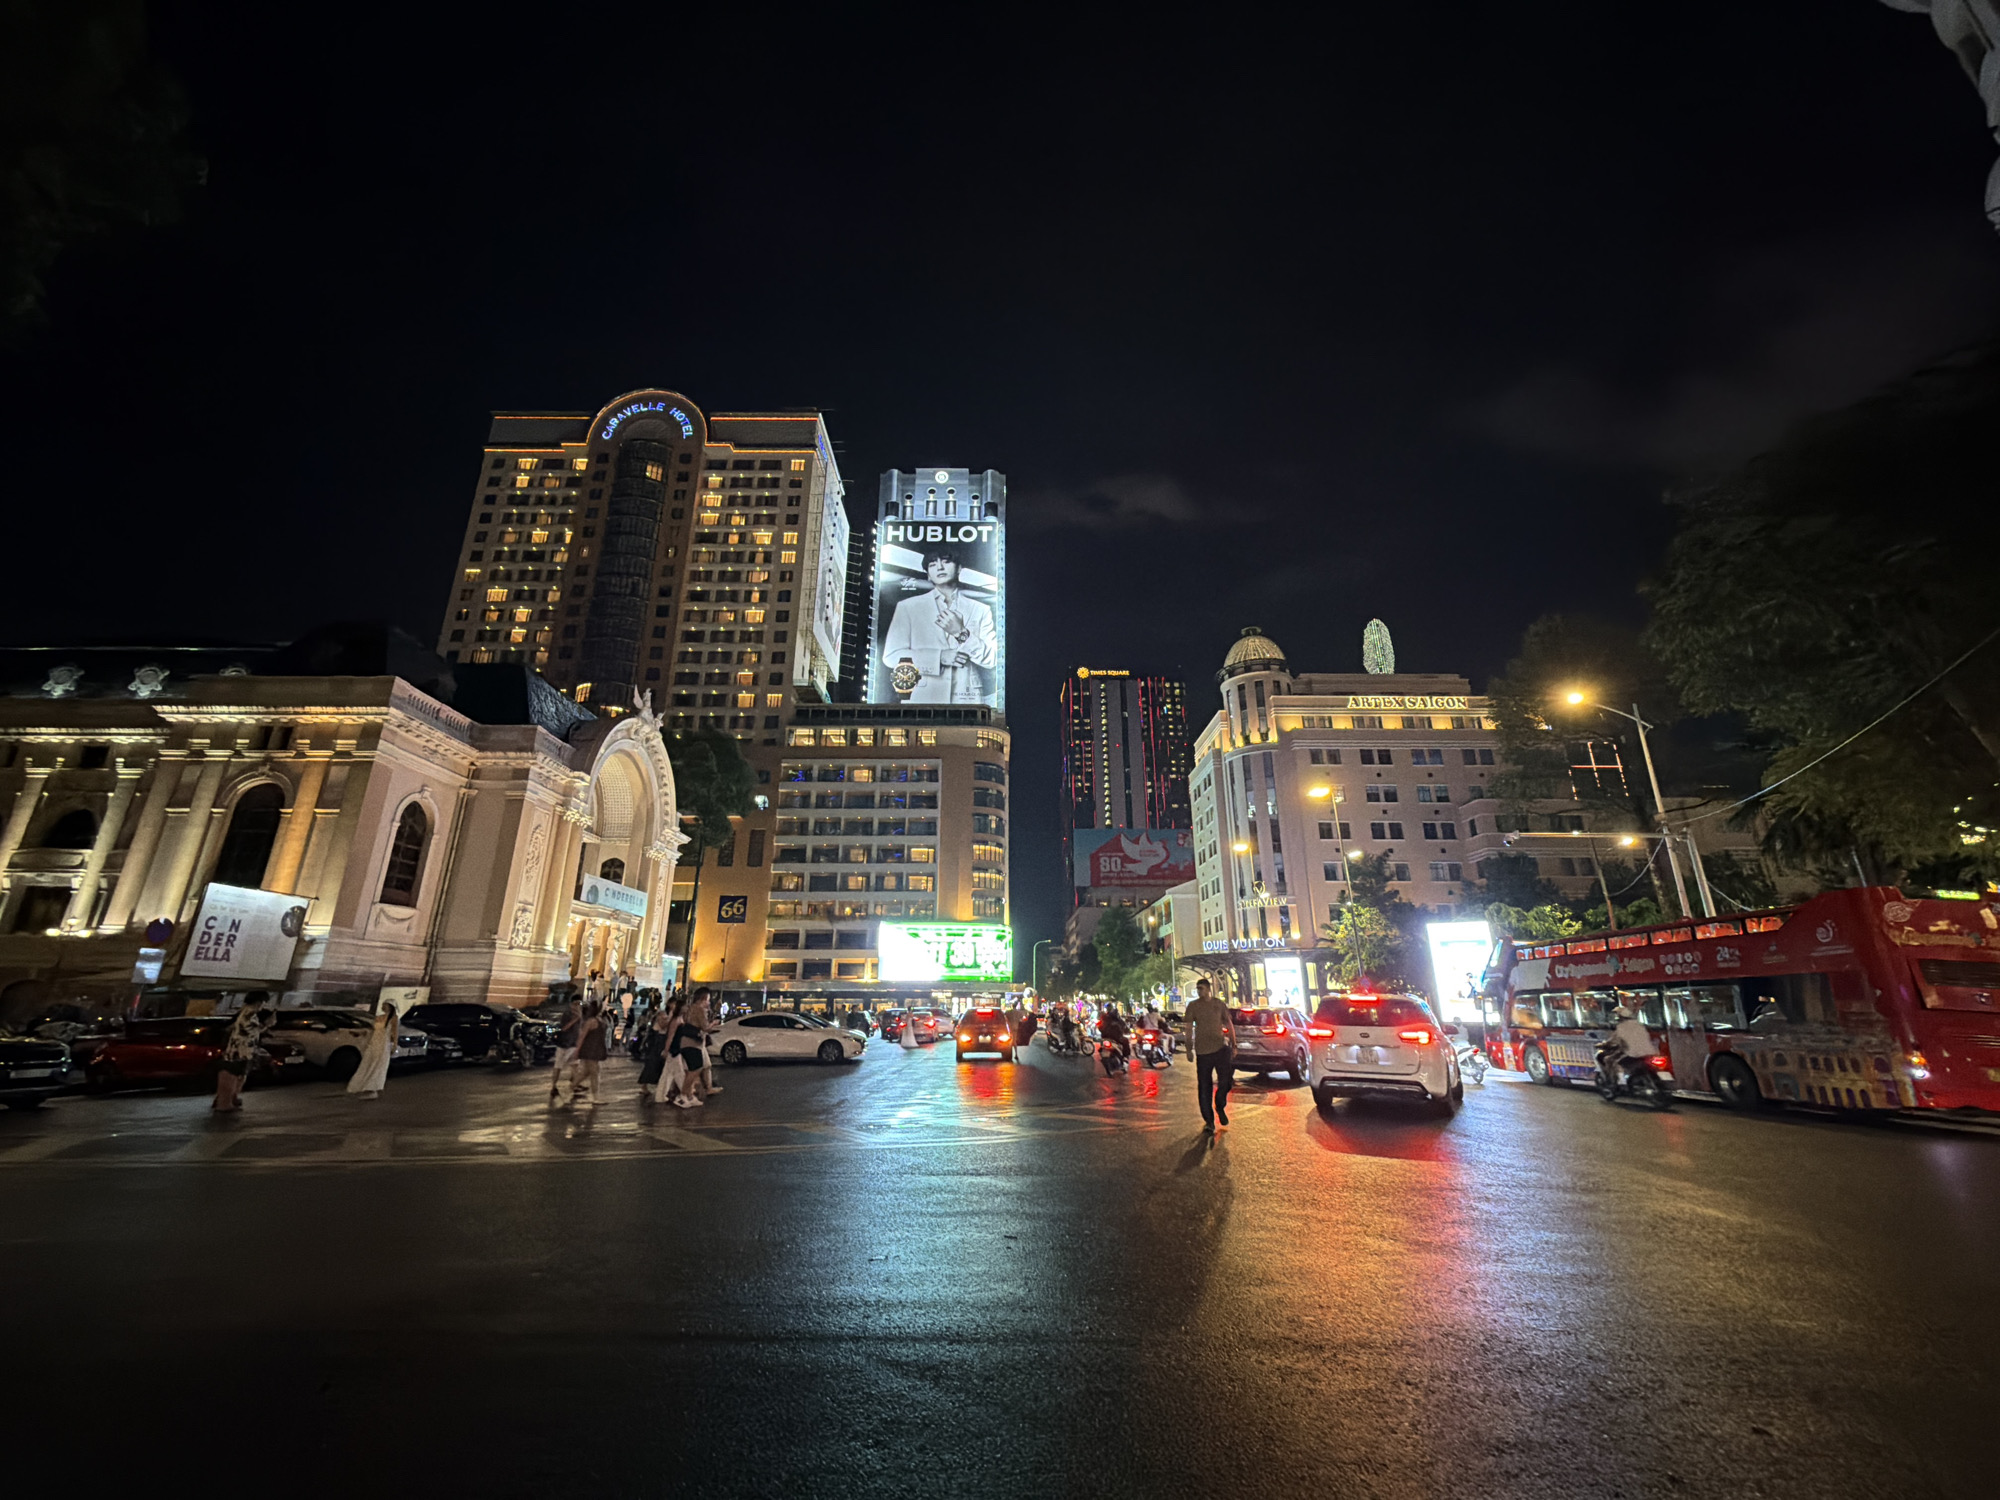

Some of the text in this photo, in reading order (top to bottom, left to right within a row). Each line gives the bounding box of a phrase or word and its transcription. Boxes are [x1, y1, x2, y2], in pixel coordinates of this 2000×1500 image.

[602, 402, 693, 439] CARAVELLE HOTEL
[887, 525, 993, 543] HUBLOT
[1090, 665, 1130, 676] TIMES SQUARE
[1347, 696, 1468, 710] ARTEX SAIGON
[720, 898, 745, 918] 66
[199, 931, 237, 948] DER
[1203, 940, 1228, 951] LOUIS
[194, 946, 230, 962] ELLA
